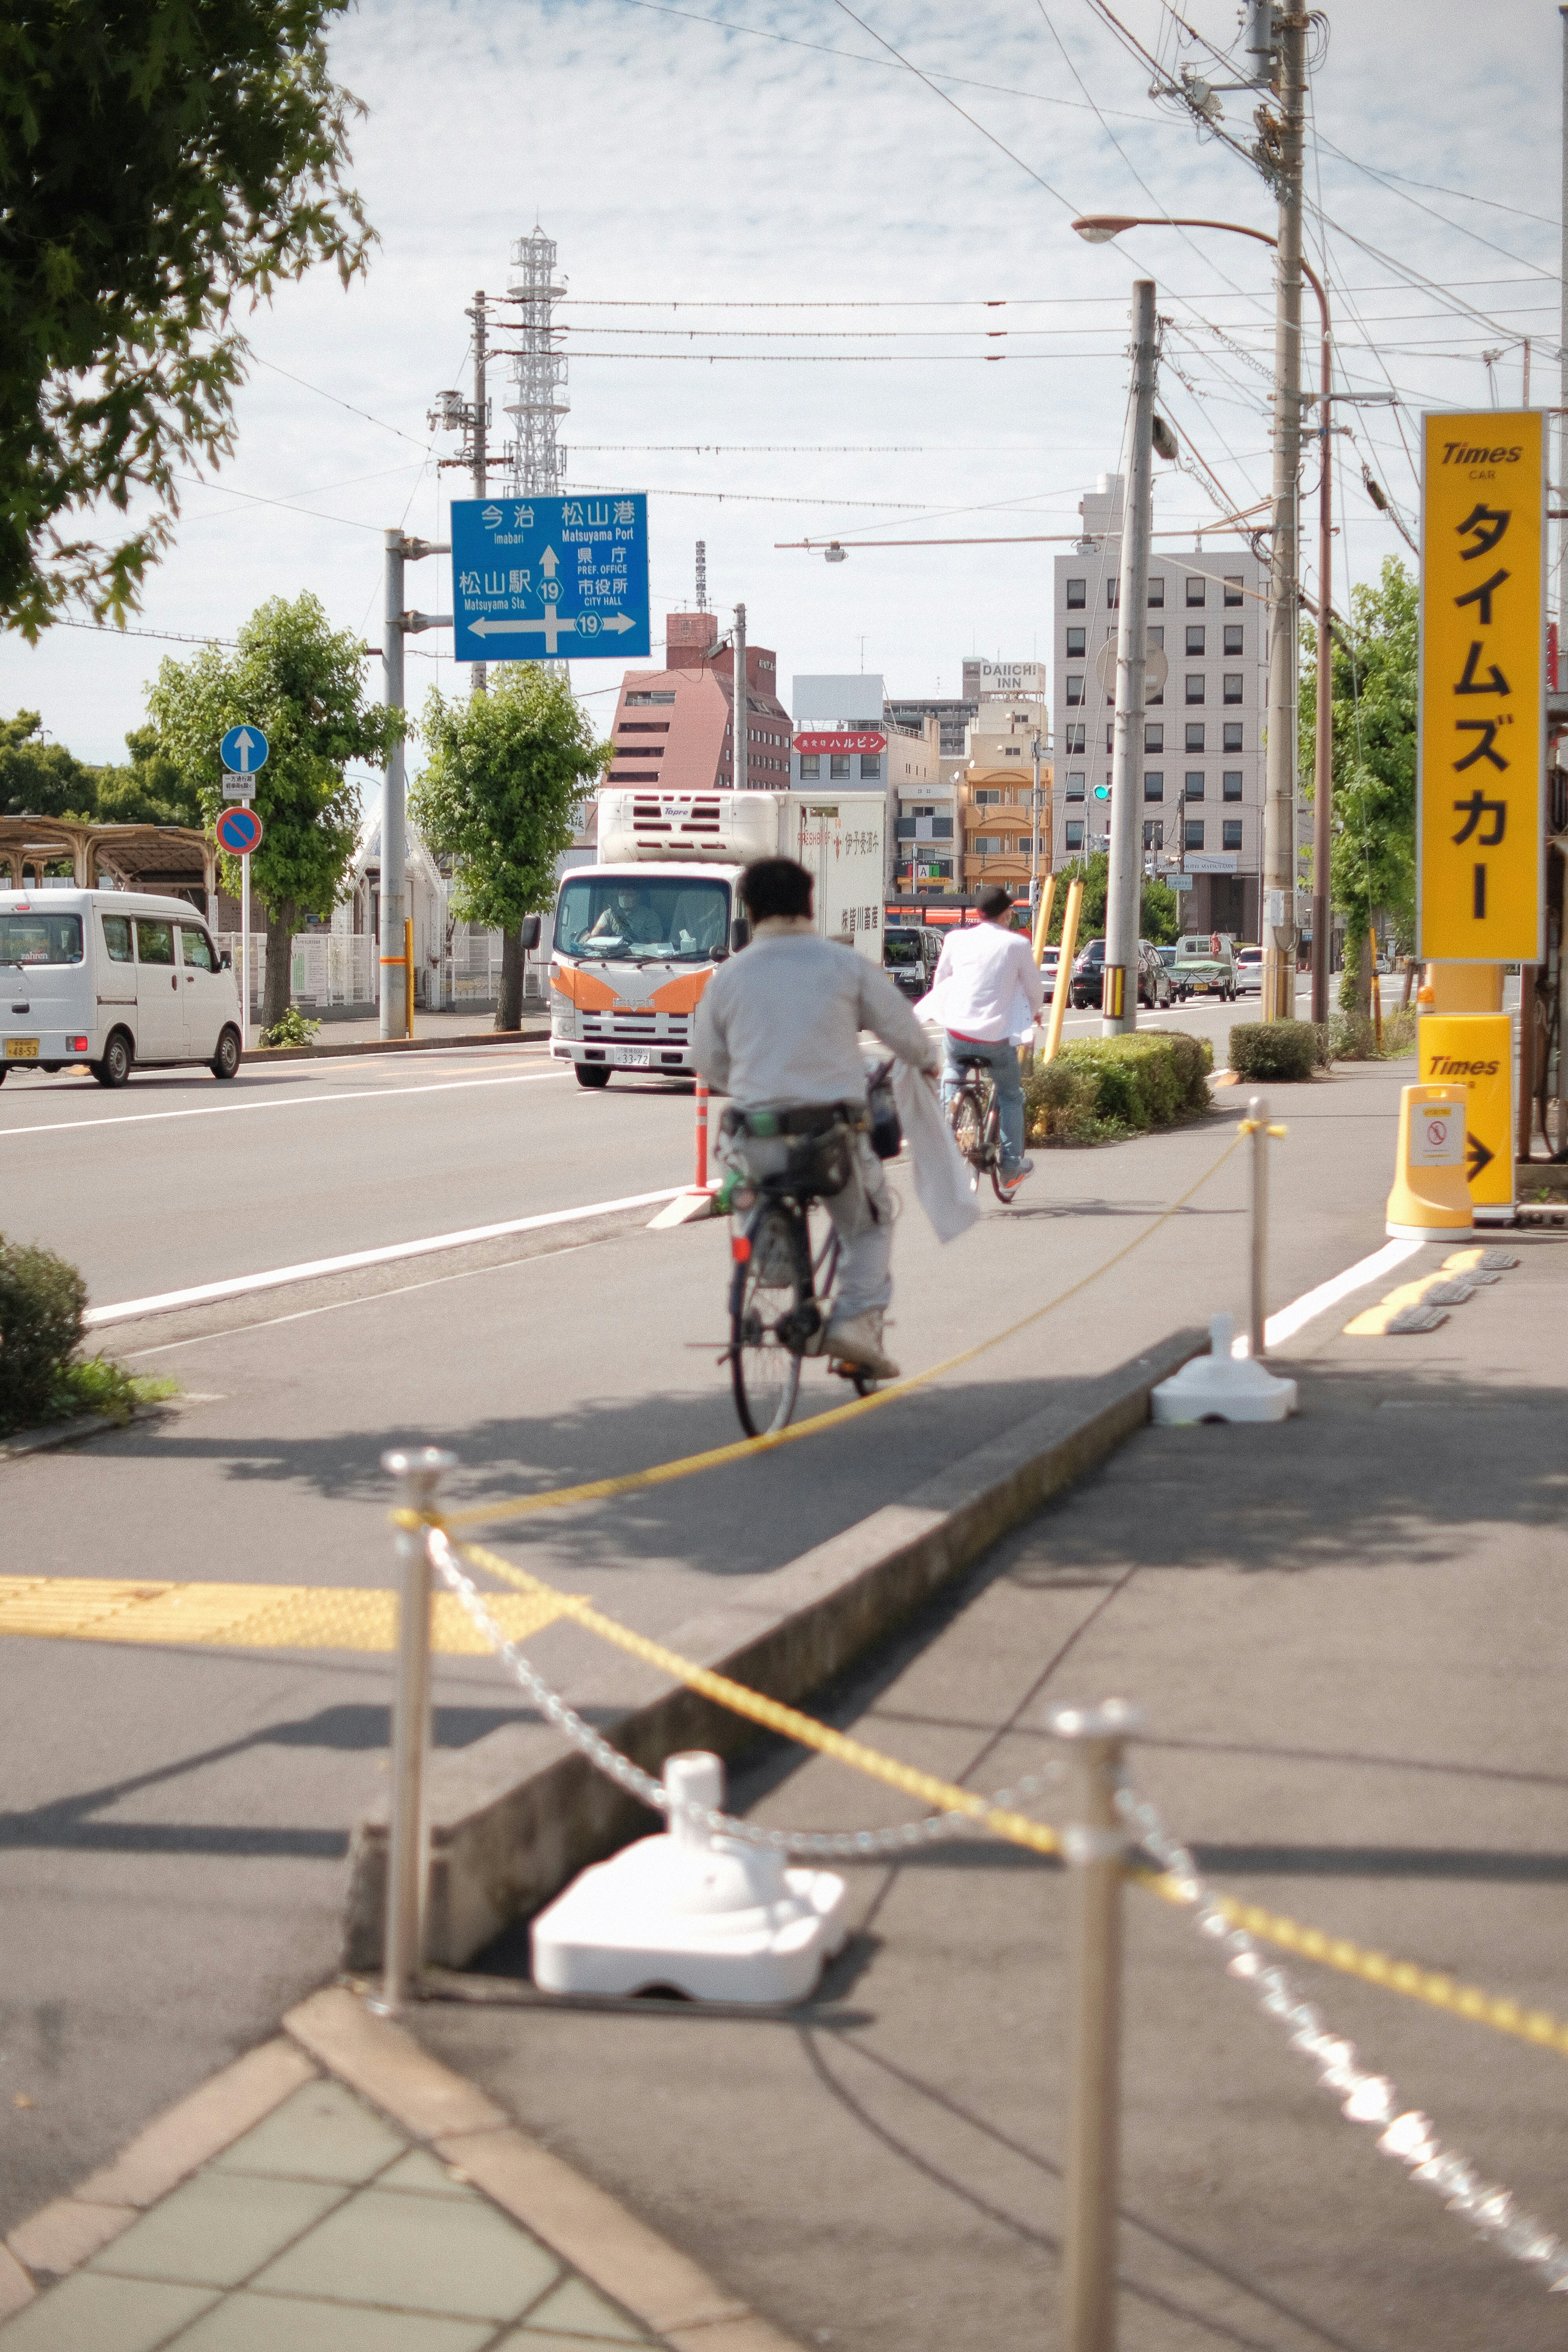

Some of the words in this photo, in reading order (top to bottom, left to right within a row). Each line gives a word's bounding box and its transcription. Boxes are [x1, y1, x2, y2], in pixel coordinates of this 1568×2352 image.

[1441, 442, 1524, 464] Times
[1468, 470, 1495, 480] CAR
[481, 504, 534, 529] 今治
[561, 500, 635, 526] 松山港
[494, 532, 524, 544] Imabari
[562, 529, 612, 544] Matsuyama
[616, 527, 634, 541] Port
[577, 547, 627, 564] 県庁
[577, 565, 598, 574] PREF.
[600, 564, 627, 574] OFFICE
[459, 569, 532, 595] 松山駅
[578, 578, 628, 596] 市役所
[541, 582, 558, 600] 19
[464, 598, 508, 612] Matsuyama
[511, 597, 526, 609] Sta.
[584, 597, 601, 606] CITY
[604, 596, 622, 605] HALL
[580, 616, 597, 633] 19
[983, 665, 1036, 675] DAIICHI
[998, 678, 1021, 688] INN
[1451, 503, 1514, 920] タイムズカー
[665, 807, 689, 816] Topre
[623, 1054, 648, 1064] 33-72
[1429, 1056, 1501, 1075] Times
